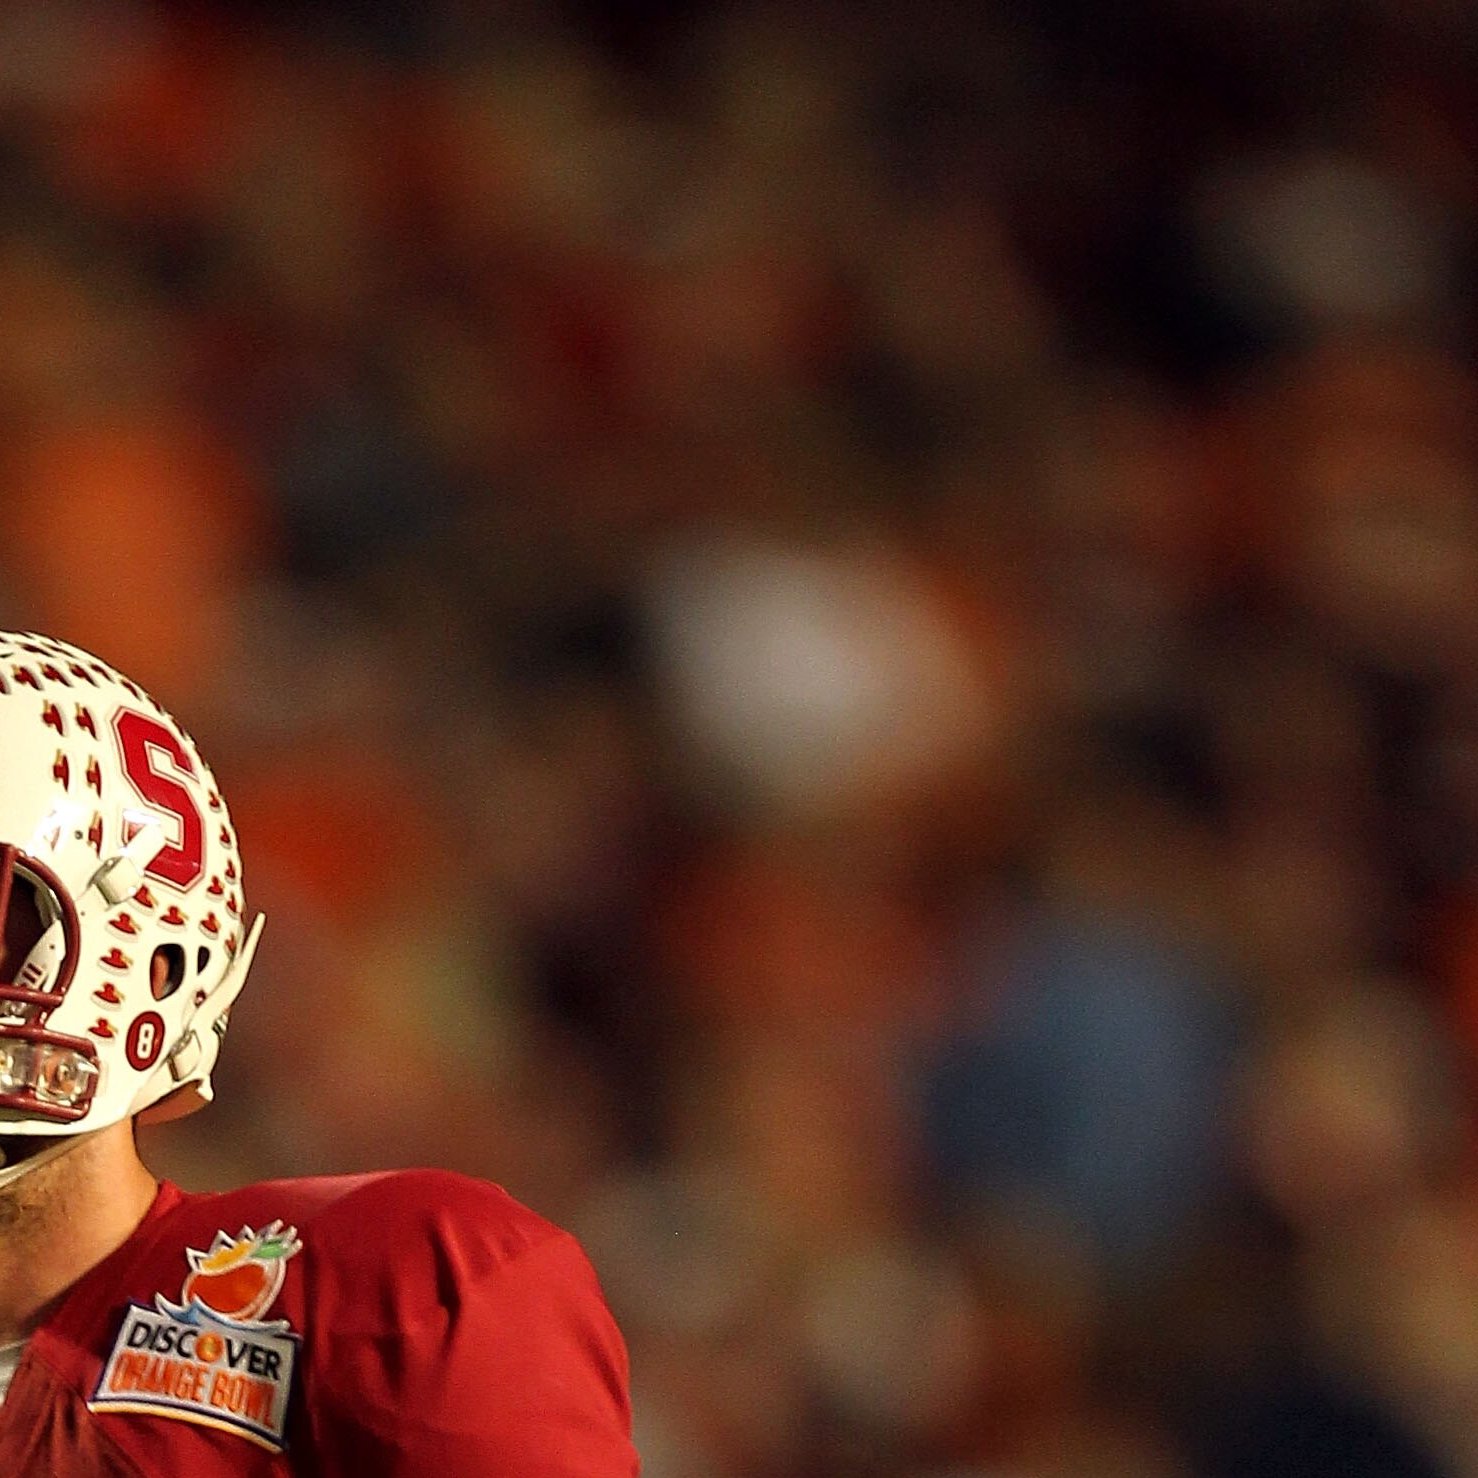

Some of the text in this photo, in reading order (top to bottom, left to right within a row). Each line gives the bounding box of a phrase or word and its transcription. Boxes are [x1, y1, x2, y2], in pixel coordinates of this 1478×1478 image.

[111, 706, 206, 893] S
[136, 1021, 156, 1060] 8
[126, 1320, 282, 1381] DISCOVER
[108, 1350, 276, 1429] ORANGE BOWL
